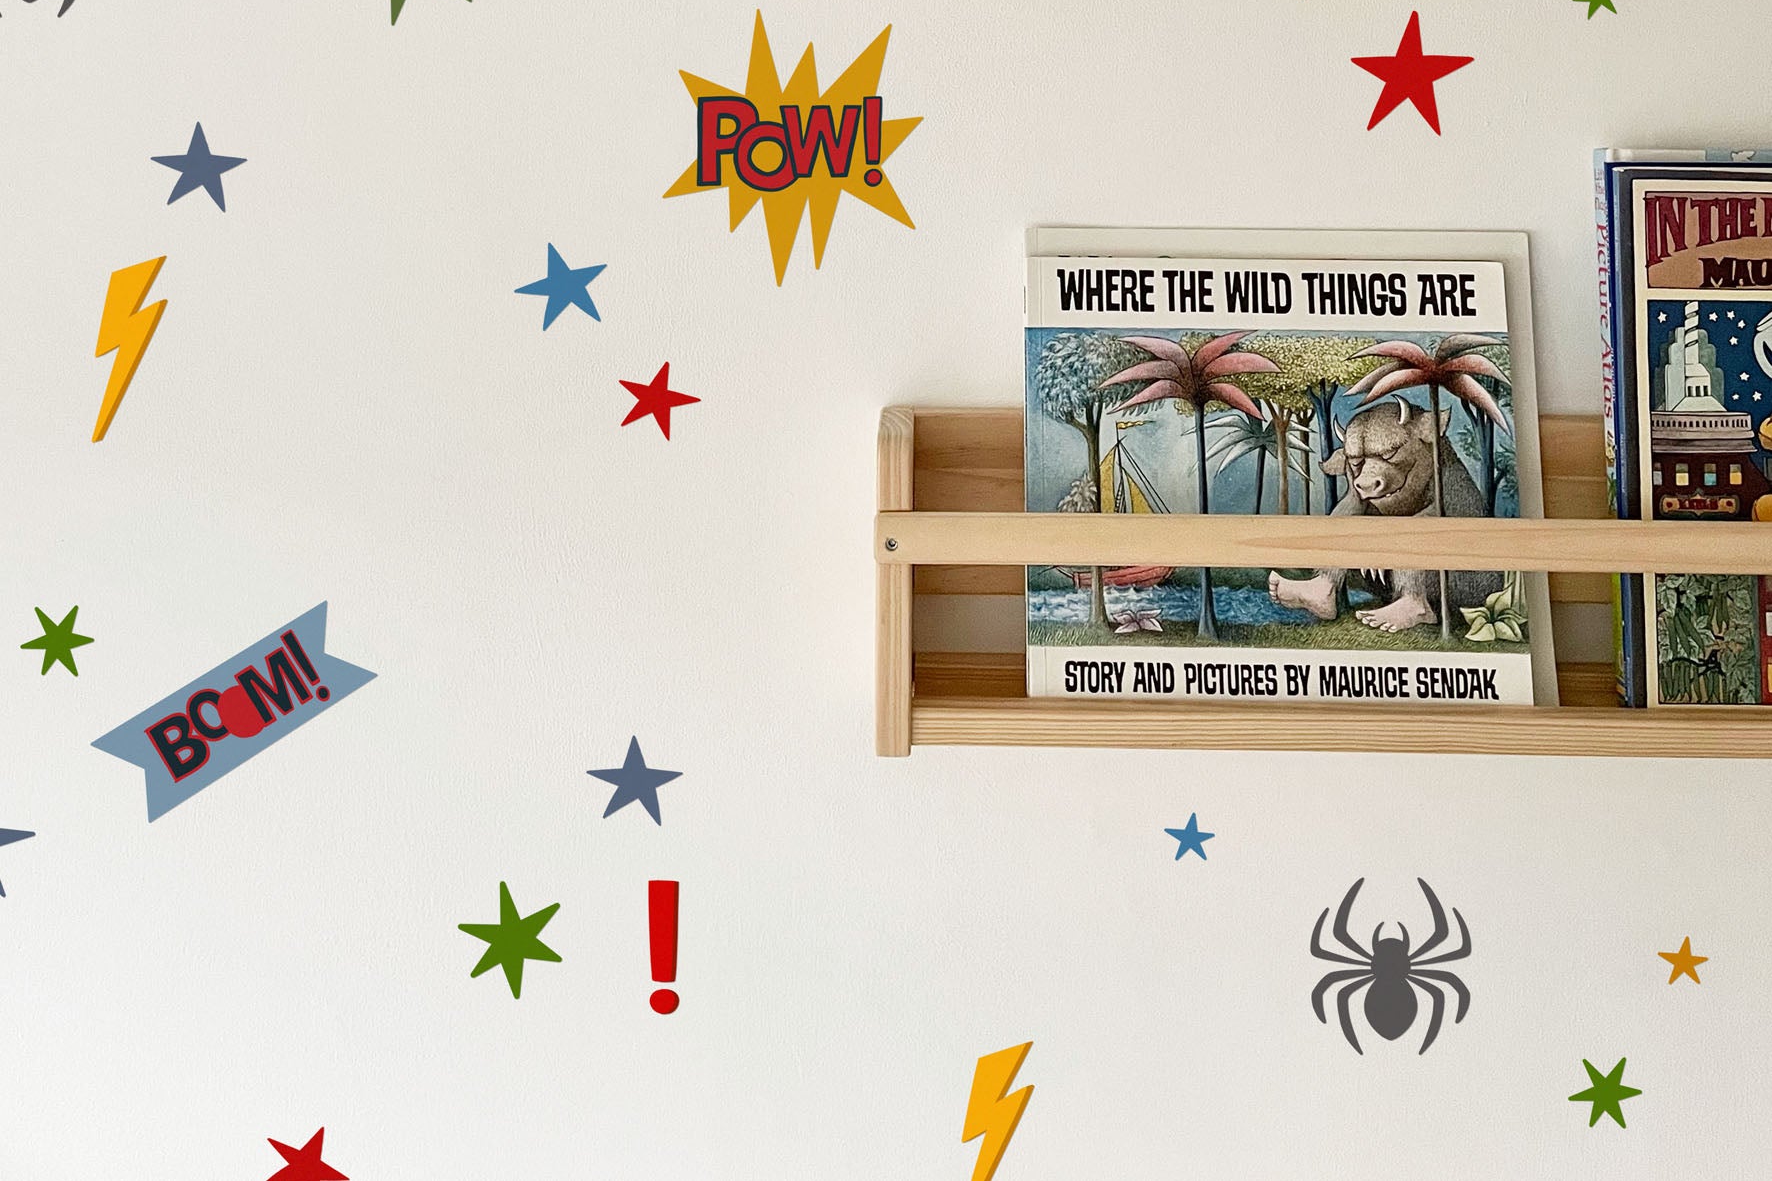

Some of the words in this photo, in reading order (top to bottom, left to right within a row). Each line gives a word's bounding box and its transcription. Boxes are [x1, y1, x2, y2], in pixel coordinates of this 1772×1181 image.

[1643, 195, 1689, 267] IN
[1690, 197, 1757, 248] THE
[1056, 268, 1155, 313] WHERE
[1162, 270, 1215, 313] THE
[1224, 270, 1292, 315] WILD
[1301, 272, 1407, 317] THINGS
[1417, 273, 1477, 317] ARE
[1064, 660, 1126, 694] STORY
[1132, 661, 1175, 695] AND
[1184, 663, 1278, 697] PICTURES
[1284, 665, 1311, 696] BY
[1319, 665, 1410, 699] MAURICE
[1415, 666, 1500, 701] SENDAK
